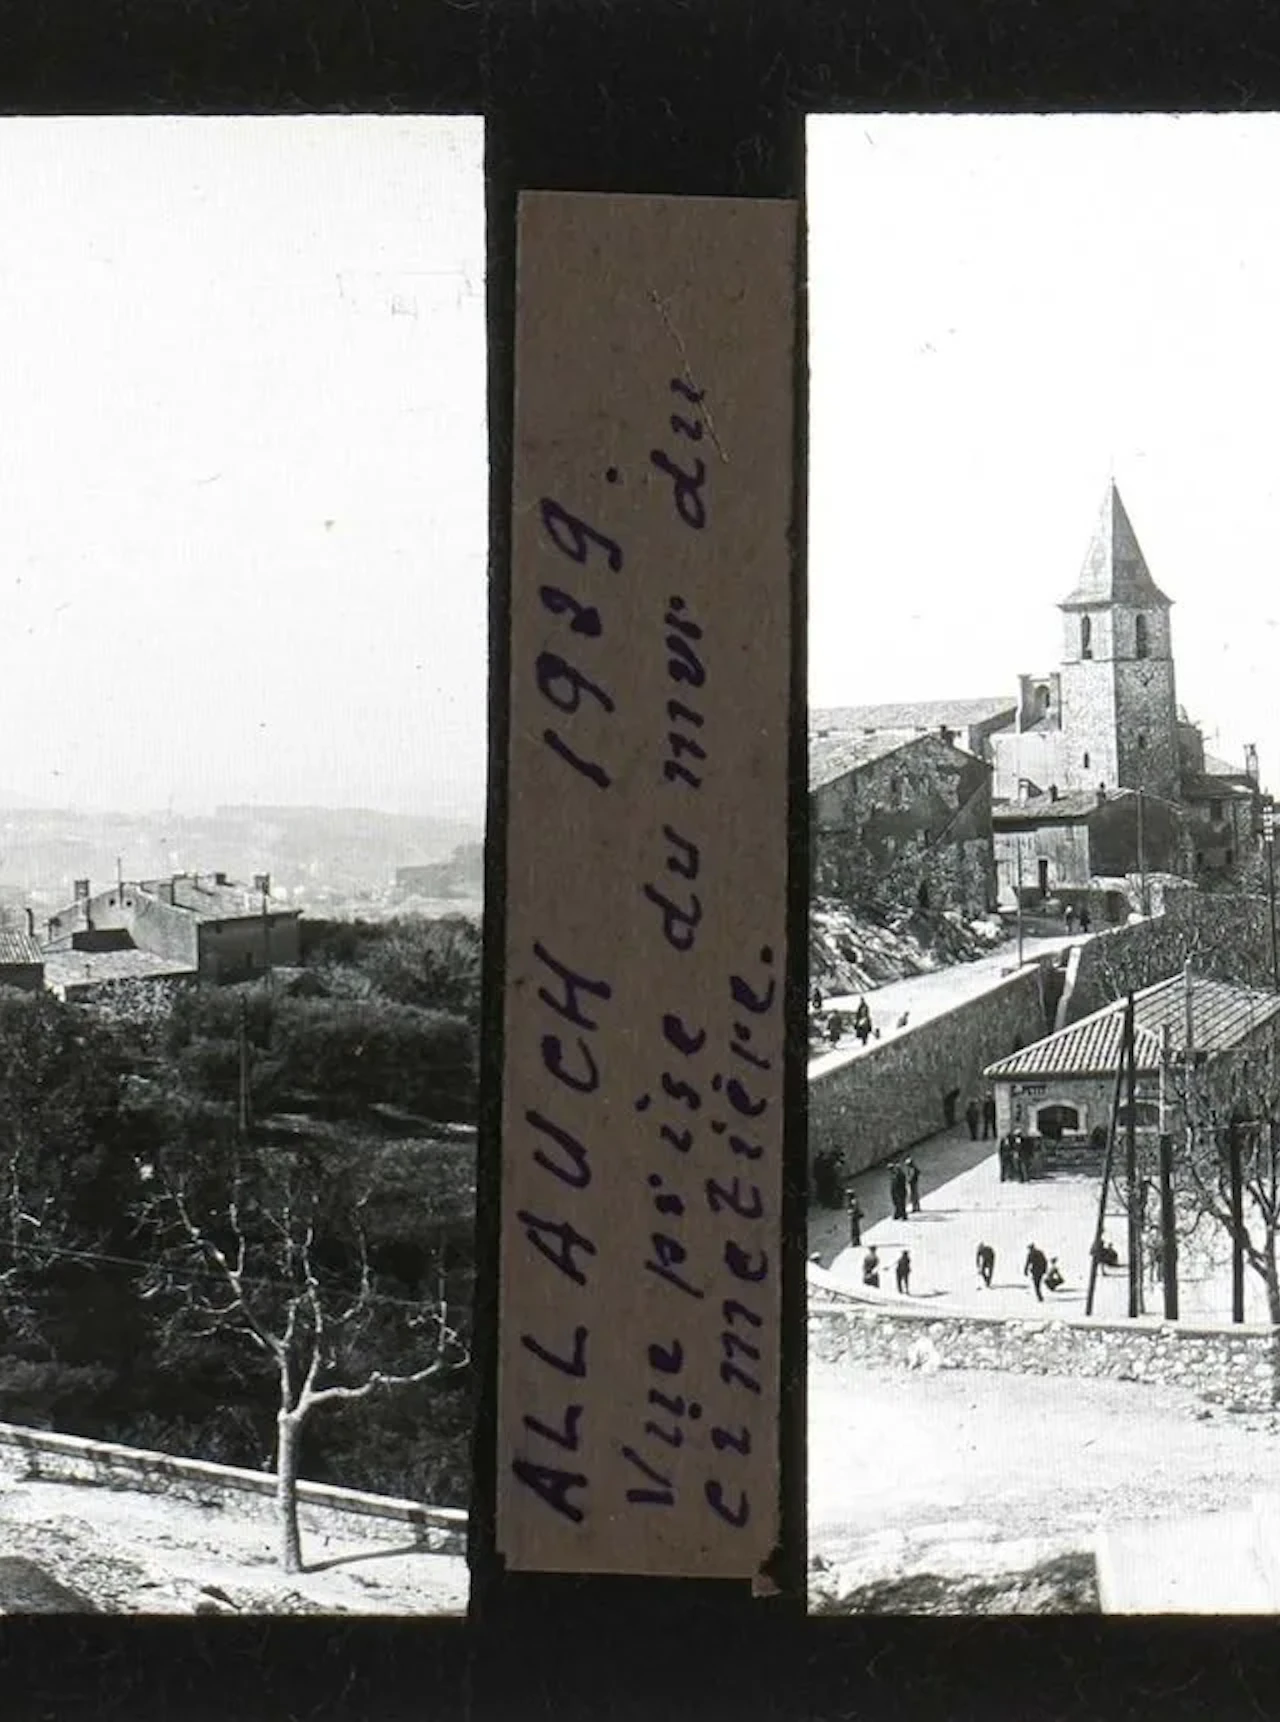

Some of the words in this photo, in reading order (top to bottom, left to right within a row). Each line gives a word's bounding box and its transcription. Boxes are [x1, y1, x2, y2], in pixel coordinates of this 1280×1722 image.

[650, 378, 706, 530] du
[663, 595, 707, 789] mur
[643, 825, 702, 951] du
[511, 941, 612, 1524] ALLAUCH
[635, 1014, 706, 1299] prise
[621, 1339, 686, 1506] Vue
